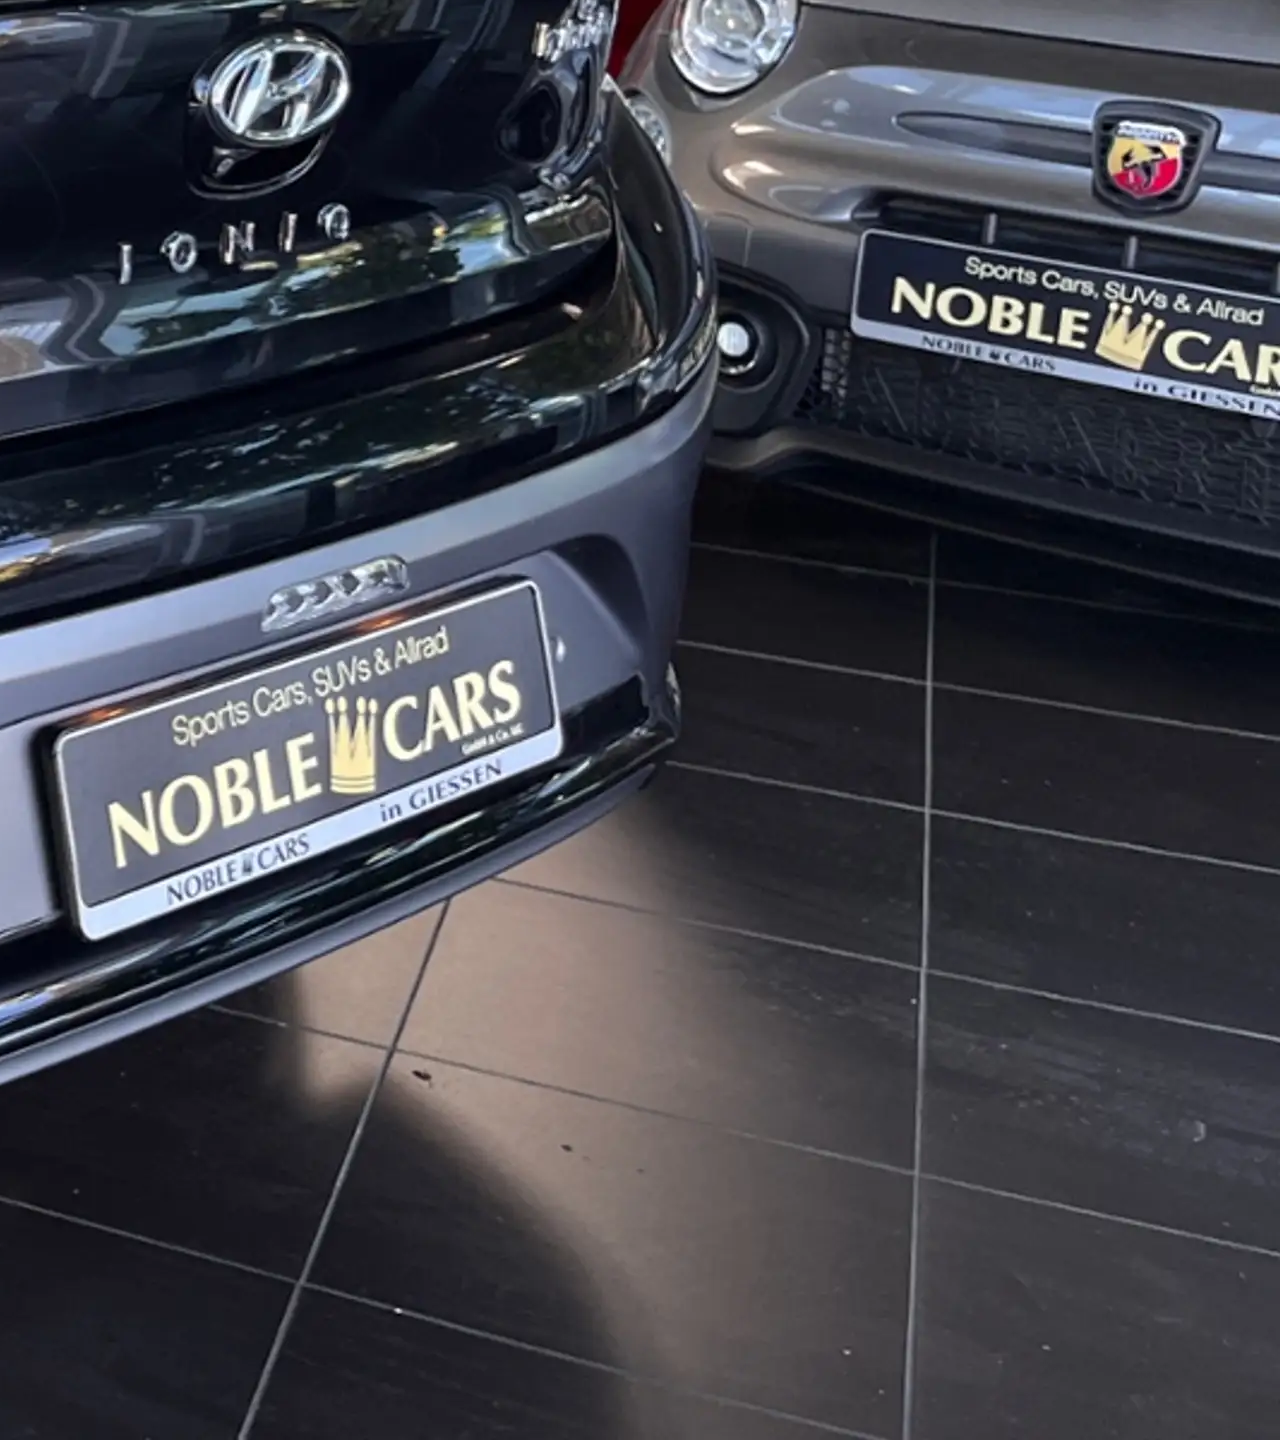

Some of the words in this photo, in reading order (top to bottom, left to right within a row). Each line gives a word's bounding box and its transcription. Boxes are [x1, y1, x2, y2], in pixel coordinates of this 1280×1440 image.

[890, 276, 1092, 350] NOBLE
[965, 256, 1037, 285] Sports
[1042, 270, 1099, 299] Cars,
[1103, 280, 1168, 310] SUVs
[1173, 293, 1191, 312] &
[1196, 297, 1265, 325] Allrad
[172, 698, 250, 747] Sports
[252, 682, 313, 717] Cars,
[312, 655, 371, 697] SUVs
[374, 647, 392, 676] &
[395, 626, 450, 668] Allrad
[107, 733, 321, 867] NOBLE
[384, 660, 522, 760] CARS
[379, 803, 403, 822] in
[408, 759, 504, 810] GIESSEN
[166, 862, 239, 906] NOBLE
[257, 832, 311, 871] CARS
